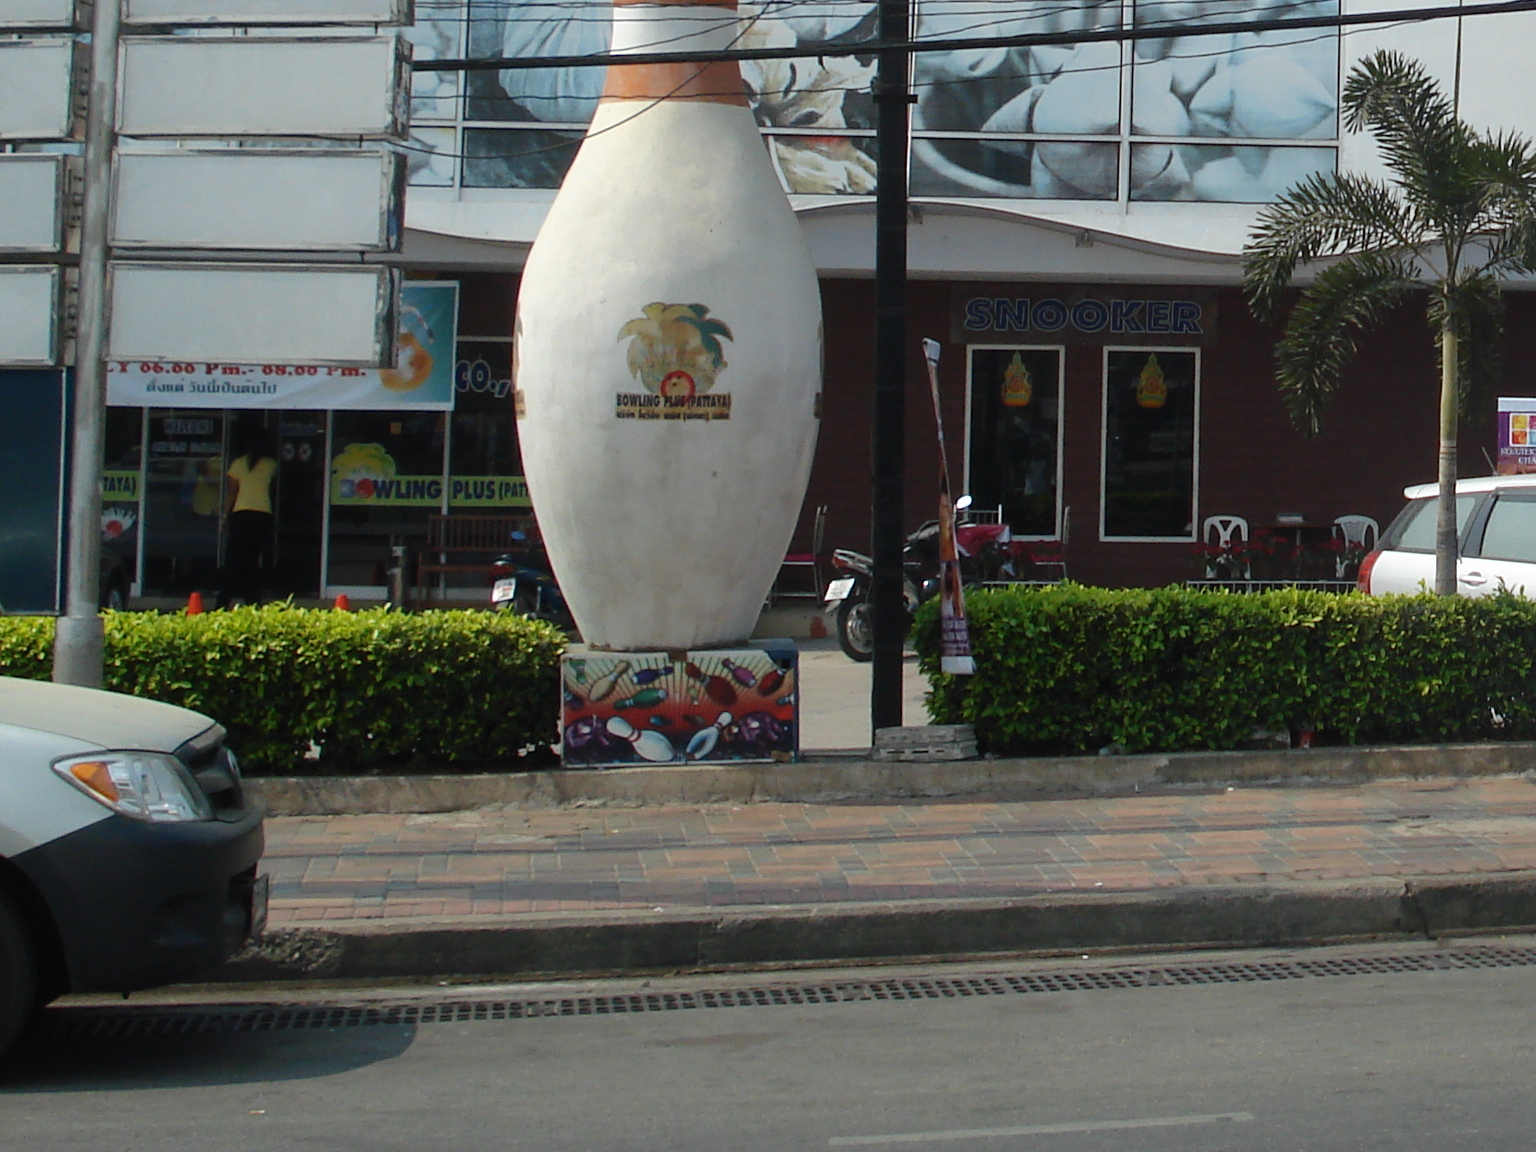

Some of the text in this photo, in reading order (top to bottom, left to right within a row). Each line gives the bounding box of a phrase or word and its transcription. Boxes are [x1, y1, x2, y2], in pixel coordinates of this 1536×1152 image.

[964, 297, 1203, 334] SNOOKER
[616, 394, 660, 408] BOWLING
[453, 480, 496, 500] PLUS
